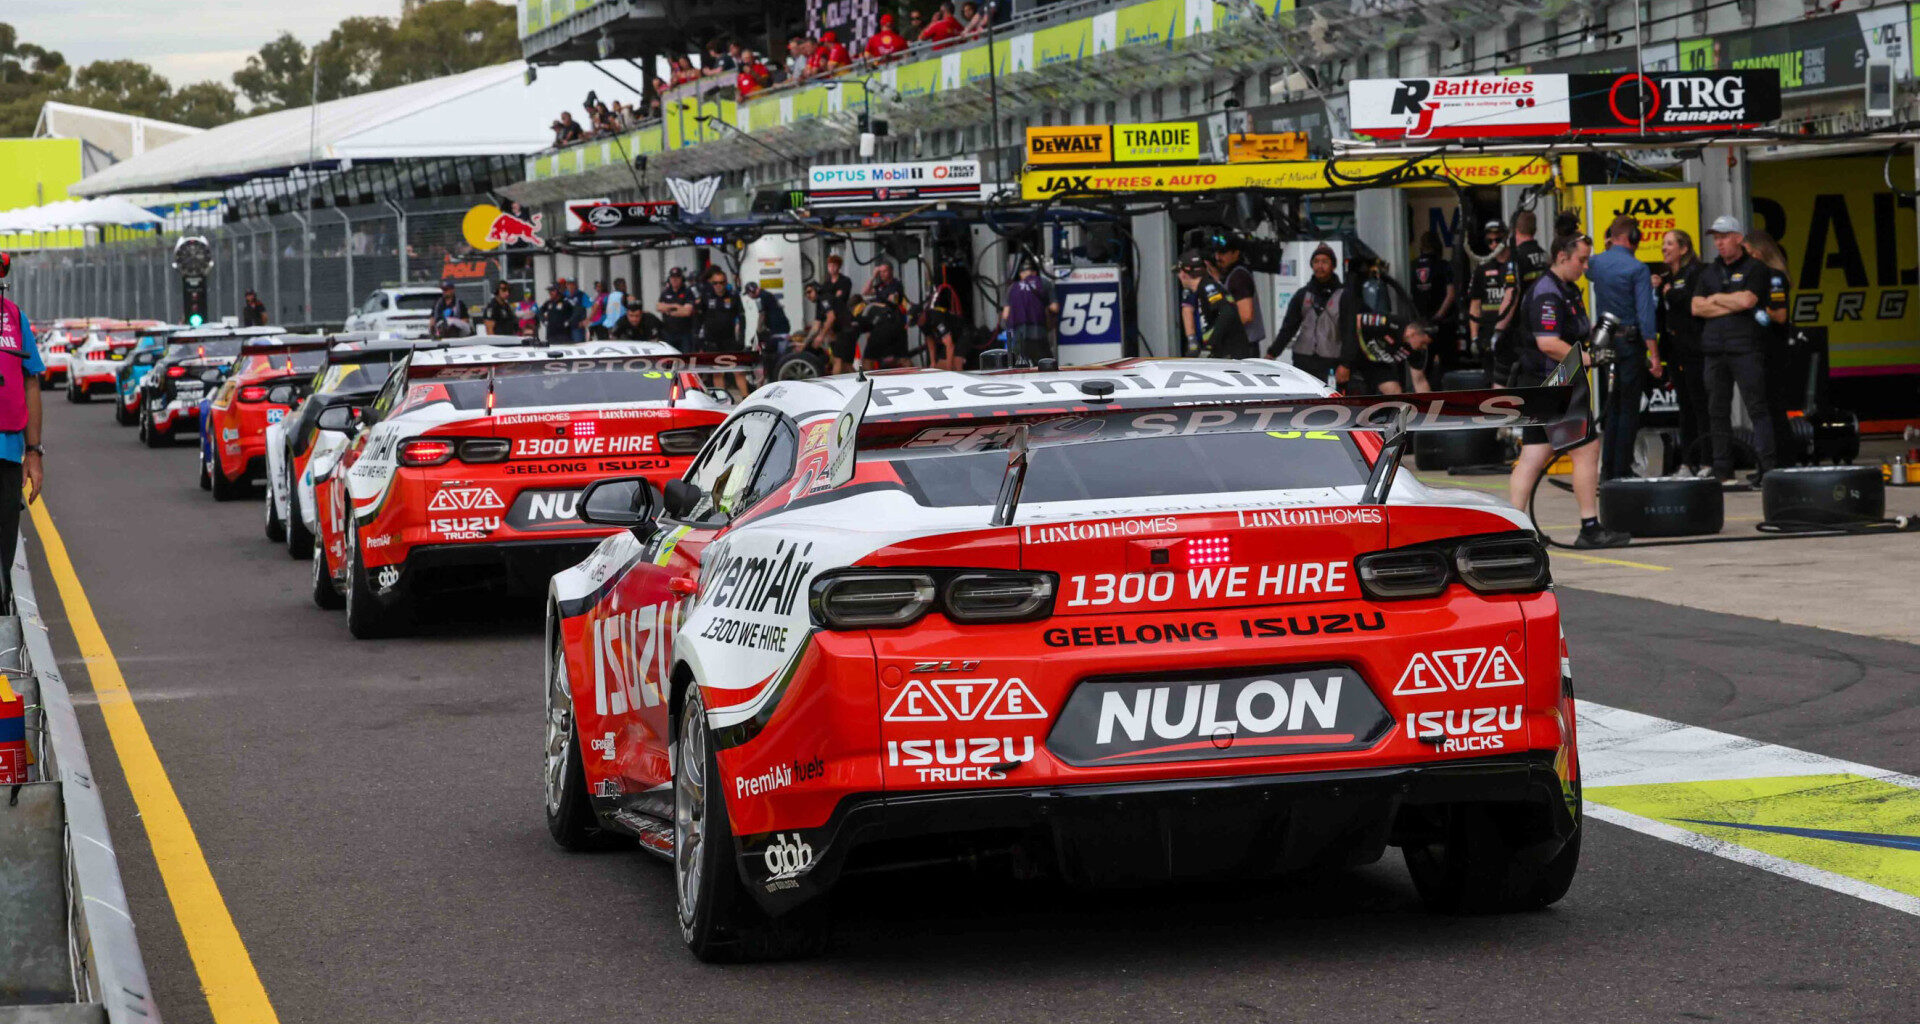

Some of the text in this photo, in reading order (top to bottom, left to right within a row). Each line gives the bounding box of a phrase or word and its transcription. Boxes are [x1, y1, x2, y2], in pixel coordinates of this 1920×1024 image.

[1433, 78, 1534, 96] Batteries
[1661, 76, 1745, 109] TRG
[1663, 108, 1746, 123] transport
[1123, 129, 1191, 148] TRADIE
[813, 170, 866, 183] OPTUS
[872, 168, 909, 181] Mobil
[1442, 164, 1500, 179] TYRES
[1516, 163, 1563, 177] AUT
[1037, 173, 1217, 193] JAX TYRES & AUTO
[628, 204, 673, 217] GROVE
[1613, 197, 1676, 216] JAX
[1059, 292, 1117, 336] 55
[871, 370, 1281, 407] PremiAir
[516, 435, 654, 456] 1300 WE HIRE
[504, 460, 671, 475] GEELONG ISUZU
[430, 516, 500, 532] ISUZU
[1237, 507, 1382, 528] Luxton HOMES
[443, 531, 487, 541] TRUCKS
[1025, 516, 1178, 545] Luxton HOMES
[1067, 561, 1348, 607] 1300 WE HIRE
[700, 616, 788, 652] 1300 WE HIRE
[1043, 611, 1386, 647] GEELONG ISUZU
[593, 600, 681, 716] ISUZU
[1096, 676, 1343, 745] NULON
[1406, 704, 1523, 739] ISUZU
[887, 735, 1035, 766] ISUZU
[735, 755, 825, 799] PremiAir fuels
